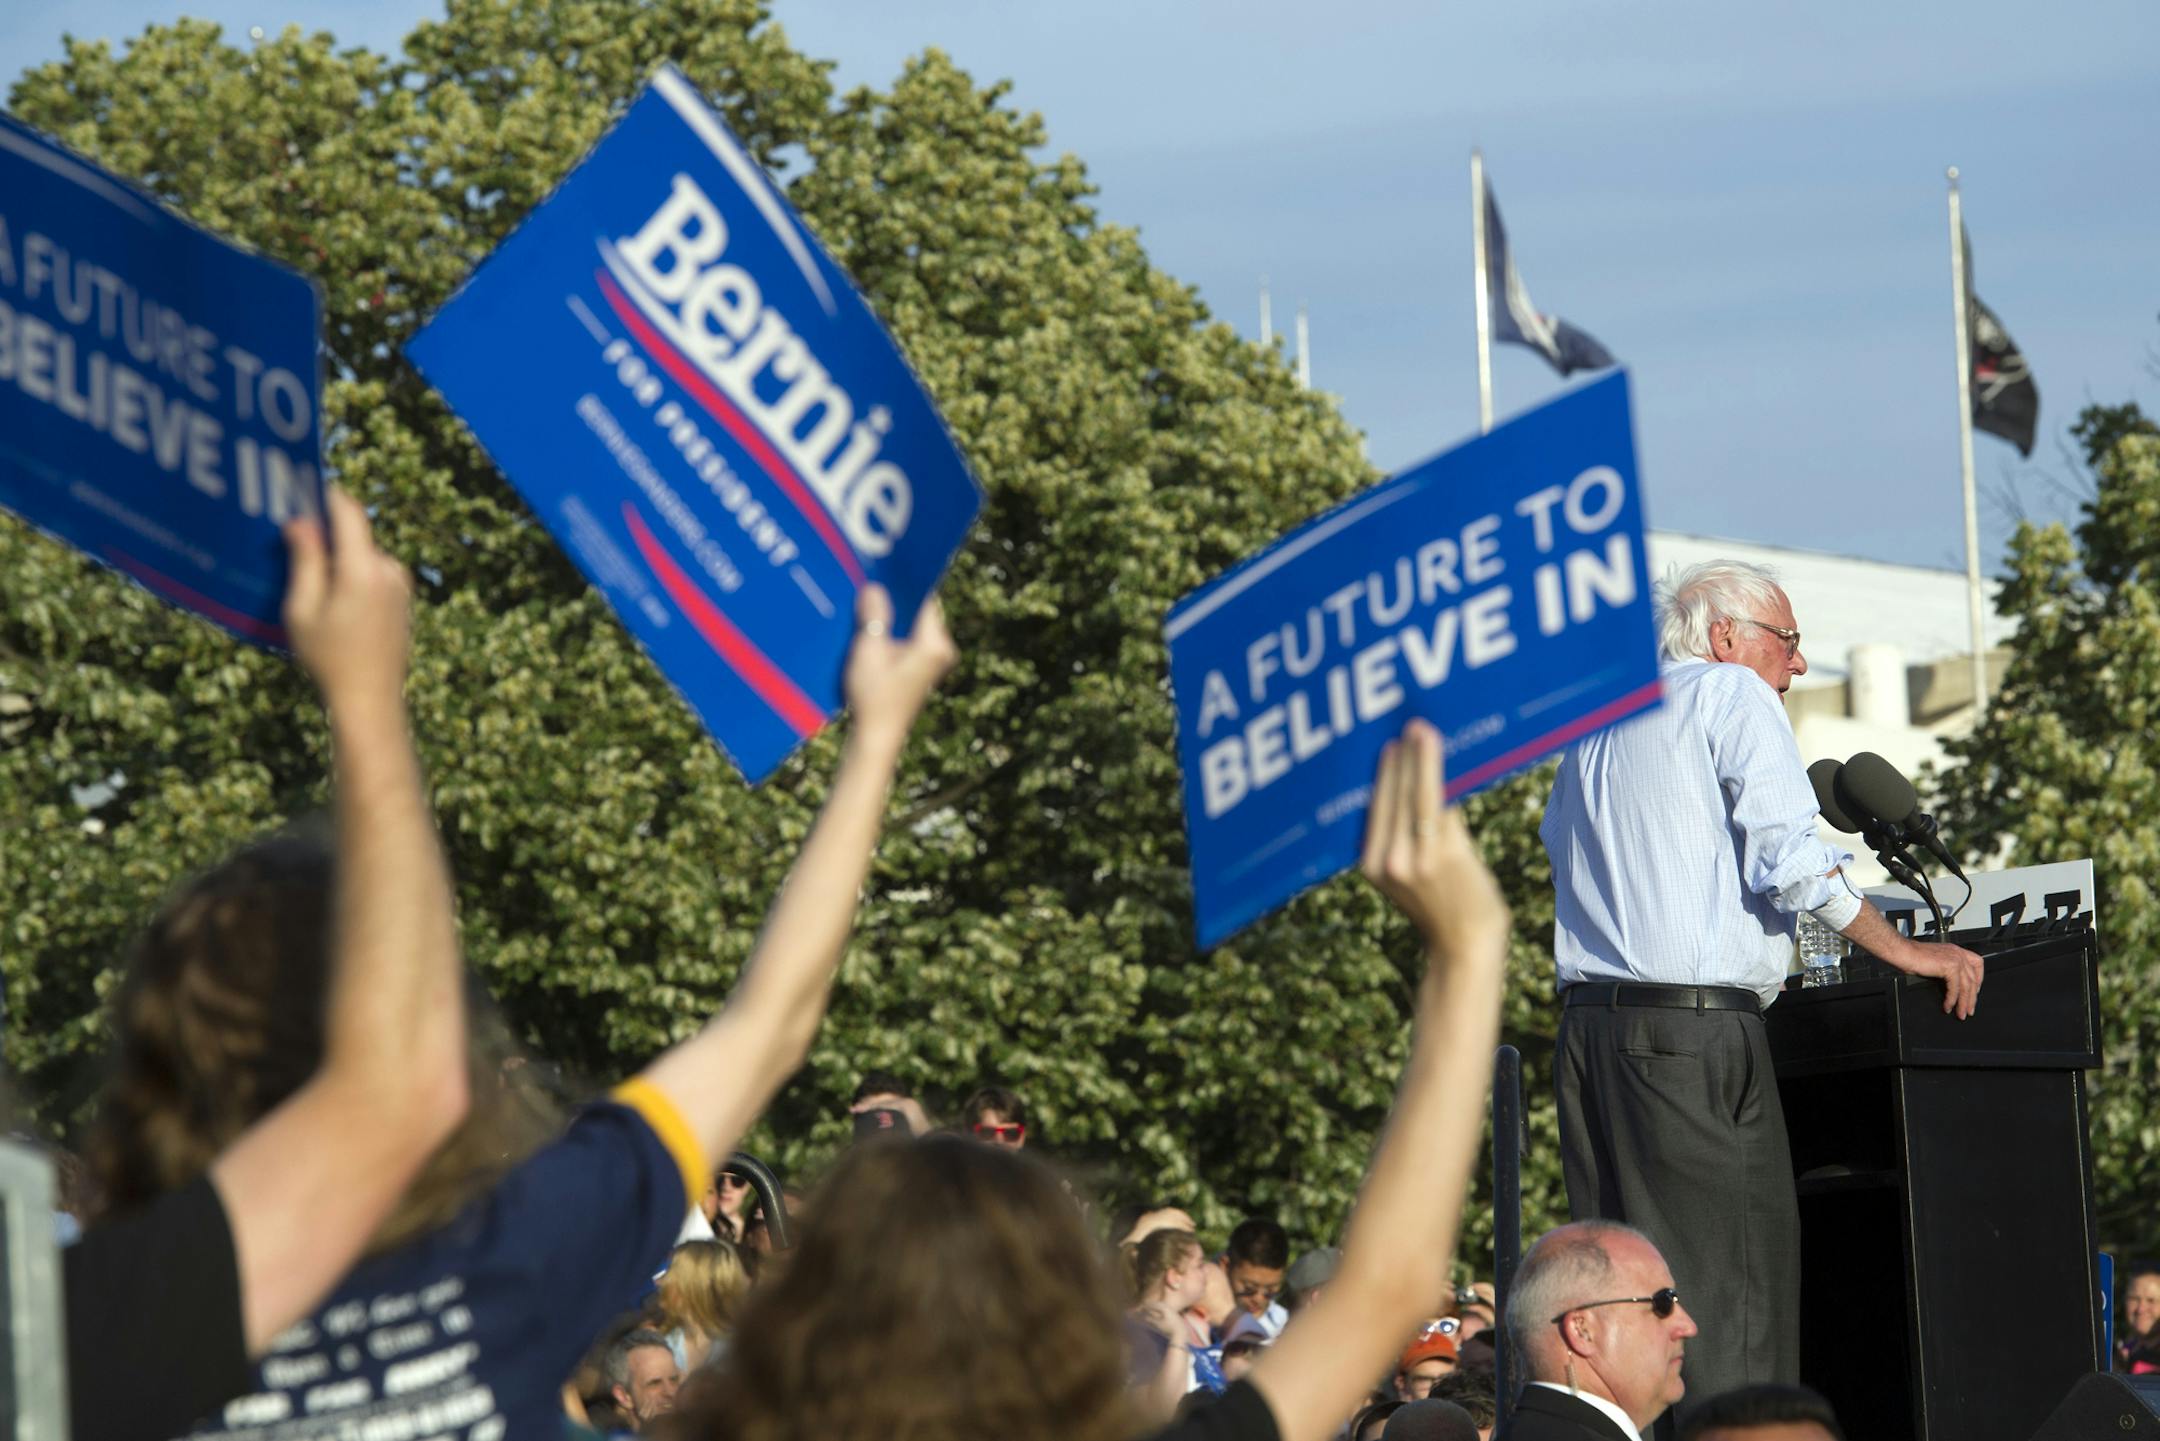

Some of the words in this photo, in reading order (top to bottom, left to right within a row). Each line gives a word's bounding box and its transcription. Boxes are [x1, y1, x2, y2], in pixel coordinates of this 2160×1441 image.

[24, 232, 219, 400] FUTURE
[224, 346, 312, 444] TO
[613, 173, 912, 561] Bernie
[1197, 670, 1239, 737] A
[1246, 514, 1505, 701] FUTURE
[1515, 465, 1625, 551] TO
[1200, 586, 1516, 818] BELIEVE
[1534, 533, 1636, 636] IN
